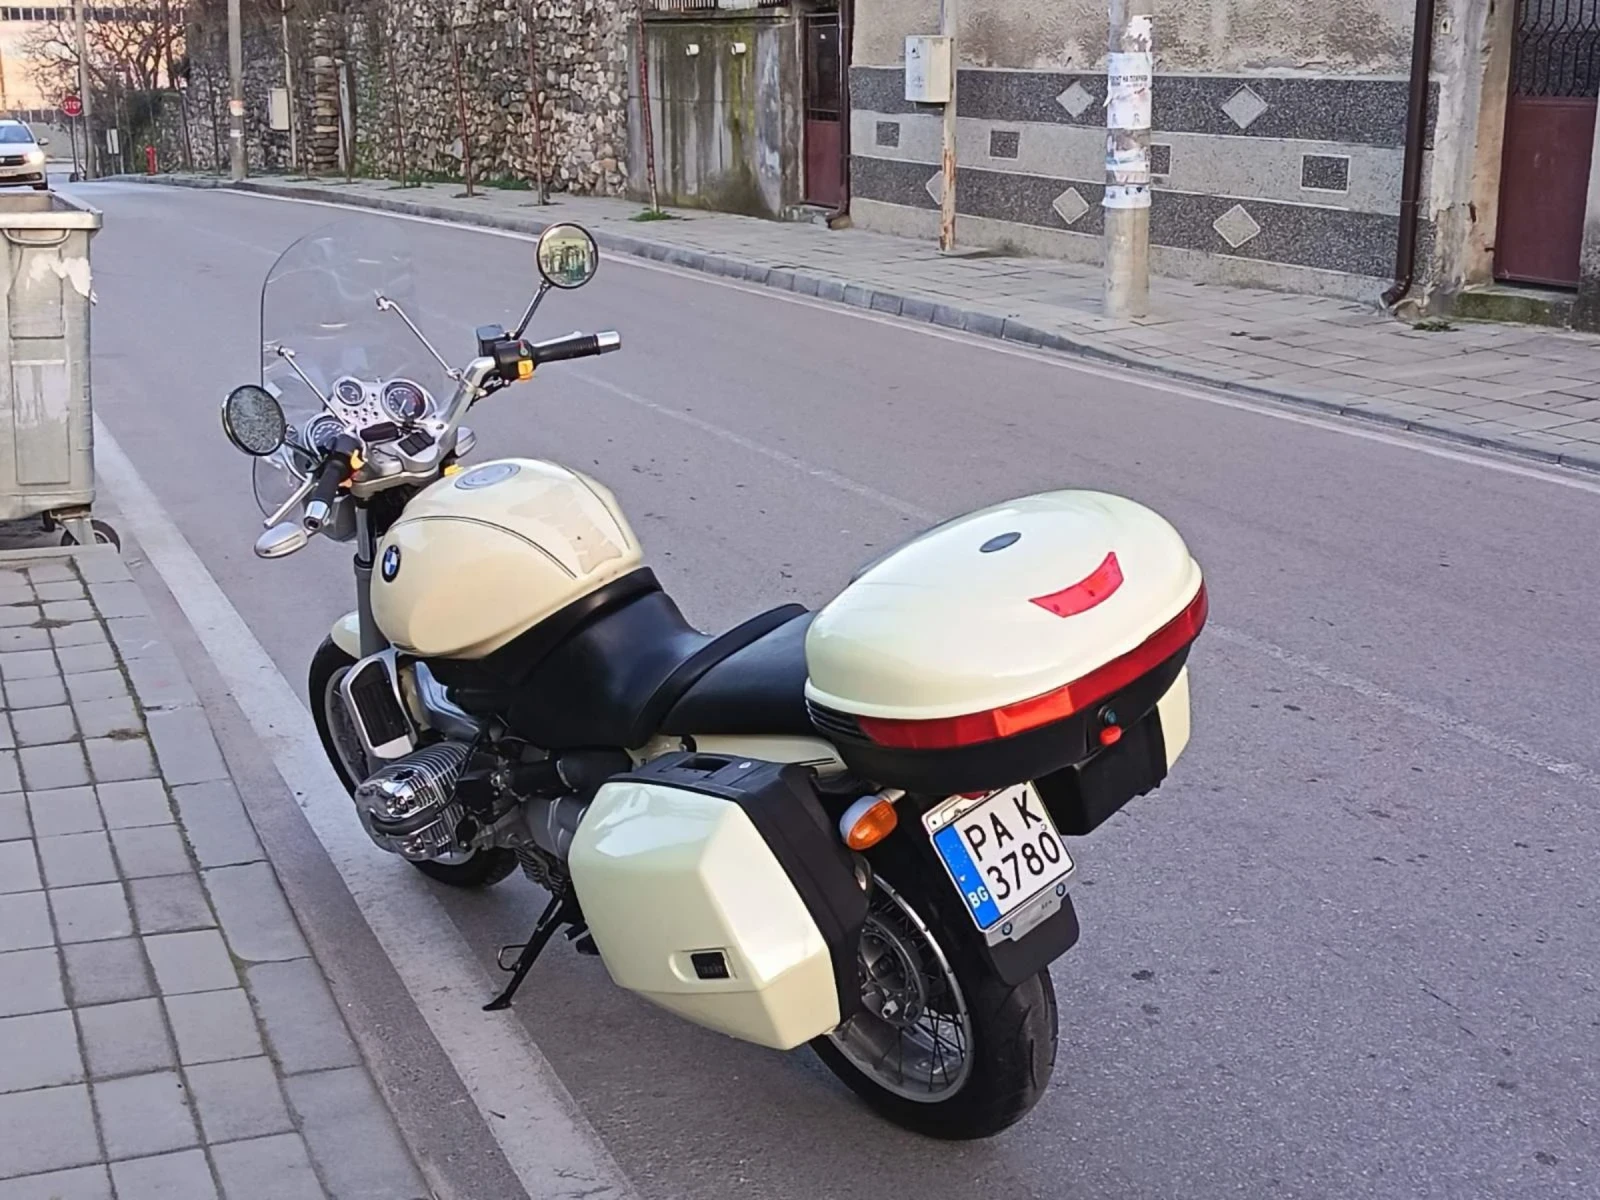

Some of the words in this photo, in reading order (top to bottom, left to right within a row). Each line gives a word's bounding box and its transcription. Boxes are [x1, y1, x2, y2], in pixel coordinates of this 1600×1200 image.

[64, 101, 81, 110] STOP
[964, 812, 1014, 861] PA
[1012, 789, 1042, 829] K
[987, 832, 1060, 900] 3780
[968, 886, 988, 909] BG
